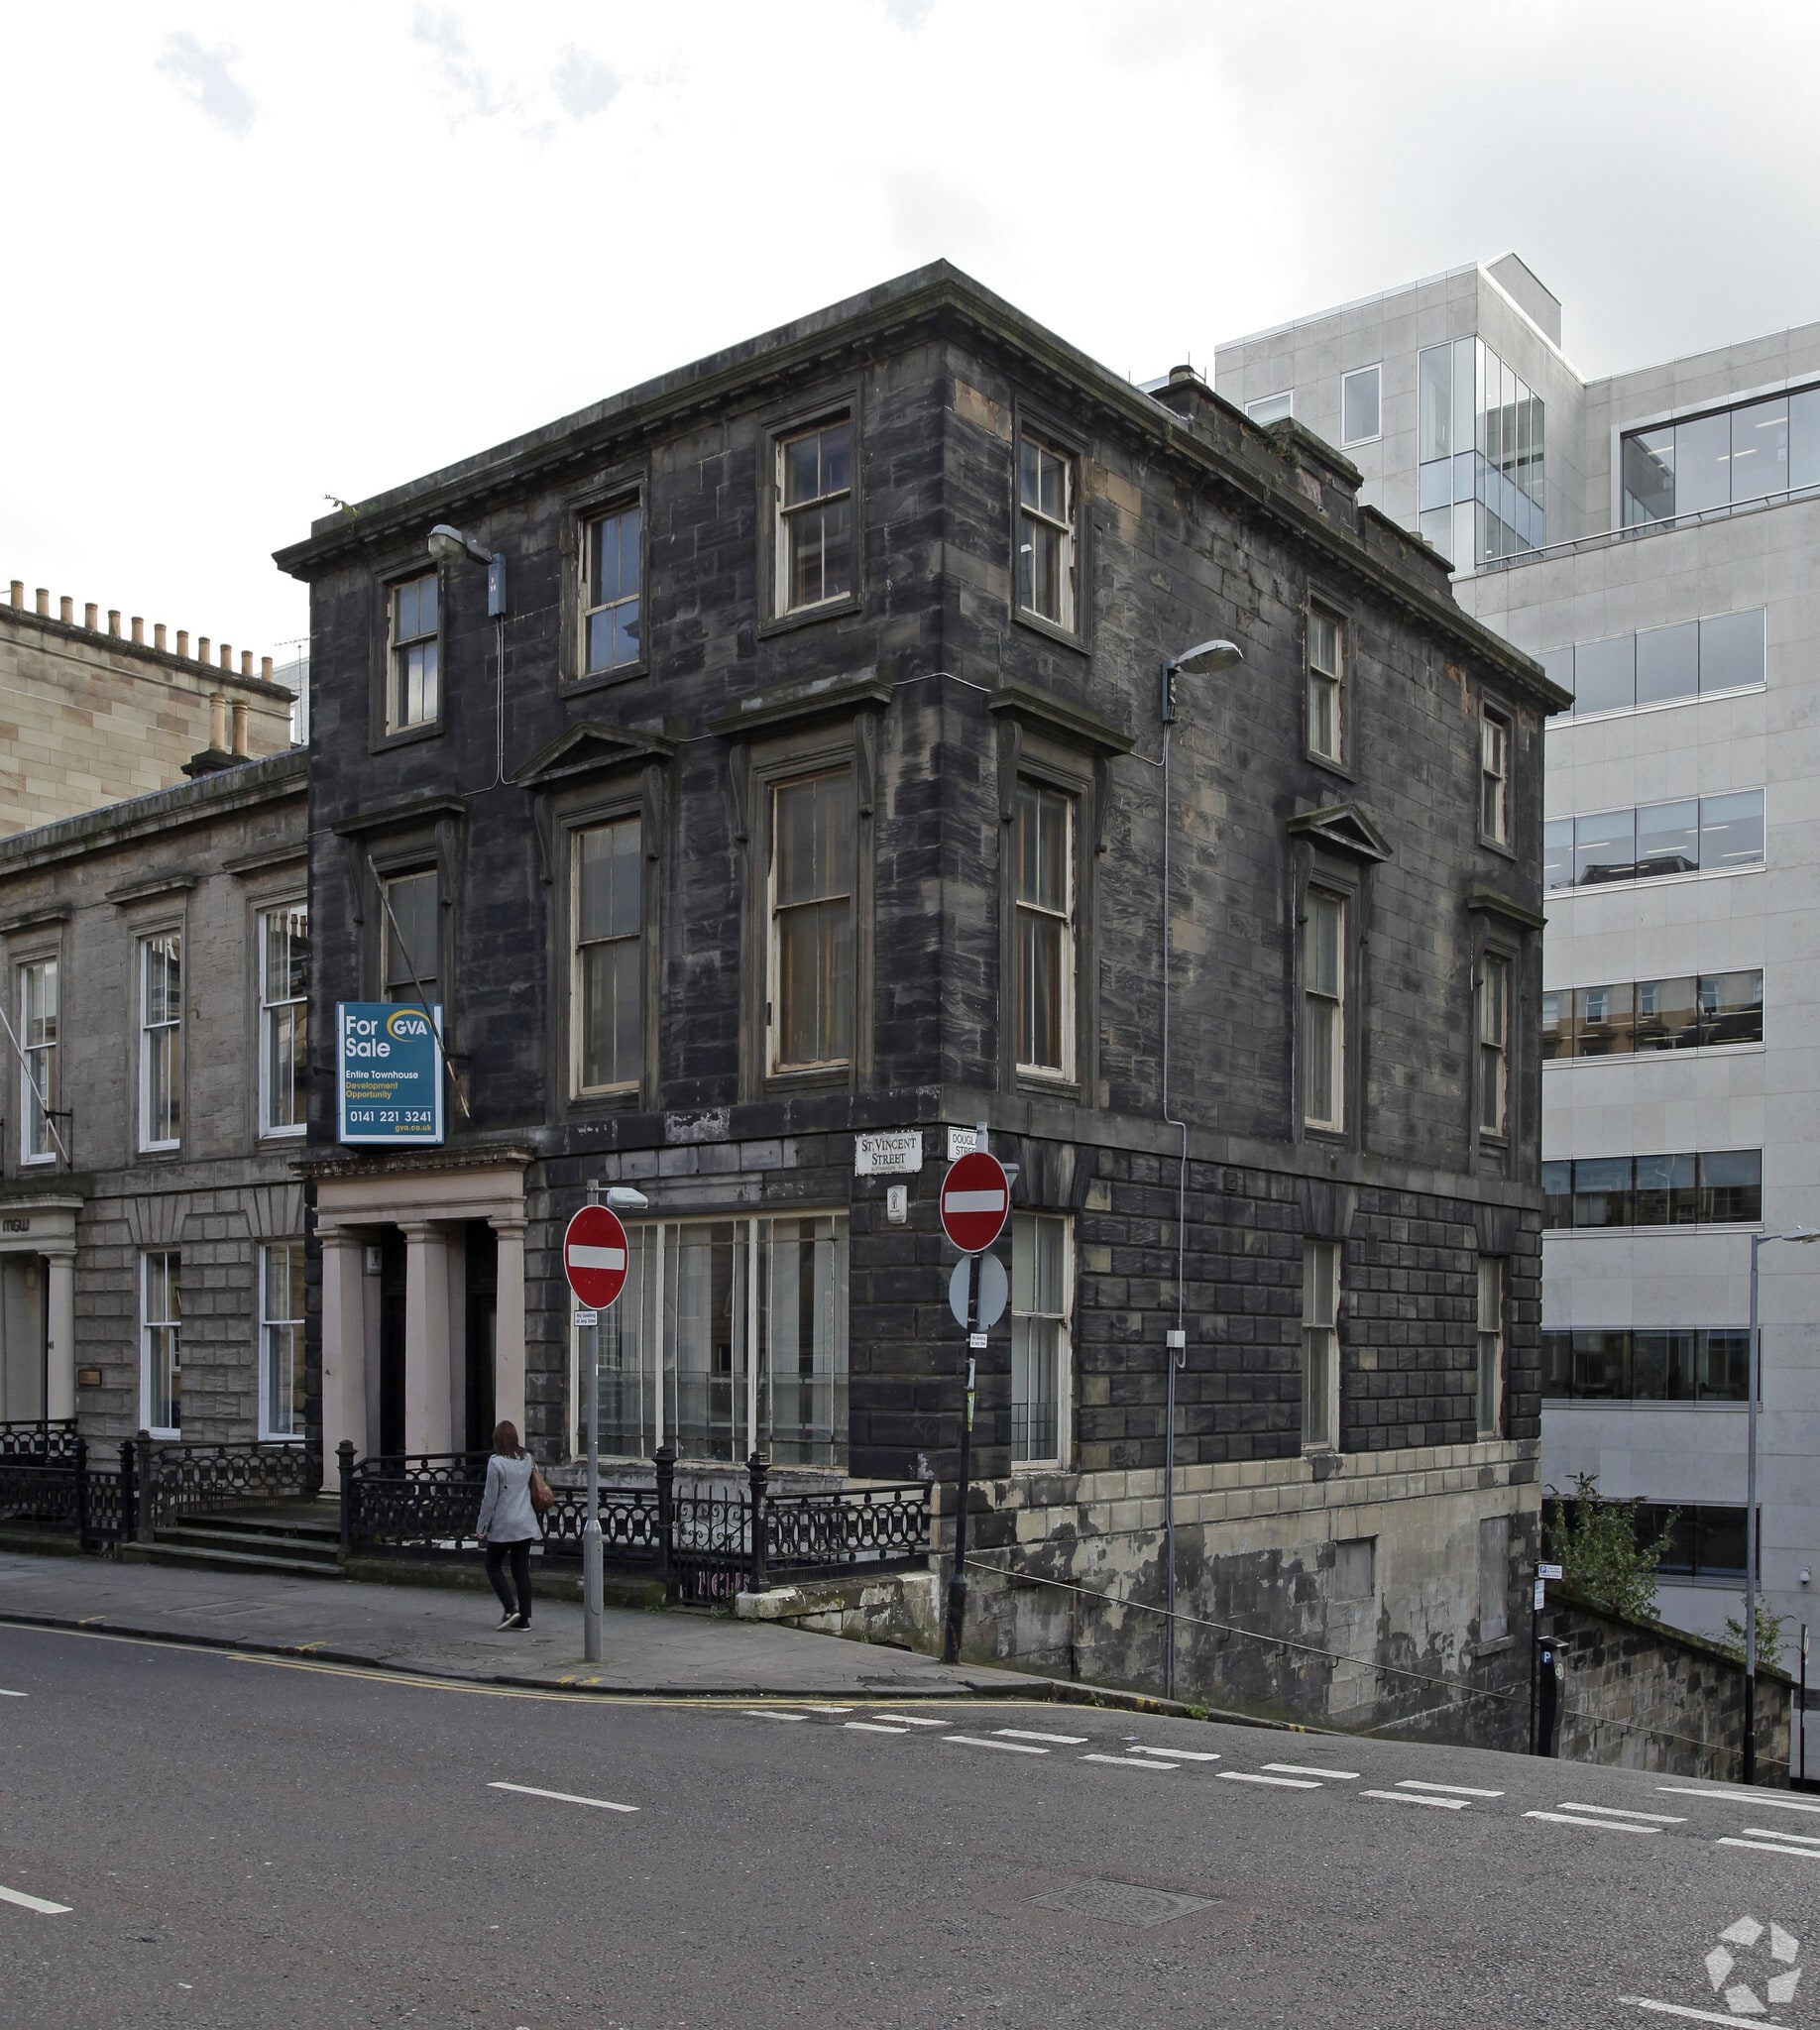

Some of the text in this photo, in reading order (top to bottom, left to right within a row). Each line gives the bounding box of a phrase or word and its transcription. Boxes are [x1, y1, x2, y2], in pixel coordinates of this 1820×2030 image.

[346, 1015, 378, 1036] For
[393, 1020, 428, 1035] GVA
[345, 1037, 392, 1058] Sale
[346, 1071, 419, 1079] Entire Townhouse
[346, 1081, 398, 1092] Development
[345, 1090, 393, 1100] Opportunity
[350, 1111, 431, 1122] 0141 221 3241
[871, 1152, 906, 1166] STREET
[1543, 1650, 1551, 1663] P
